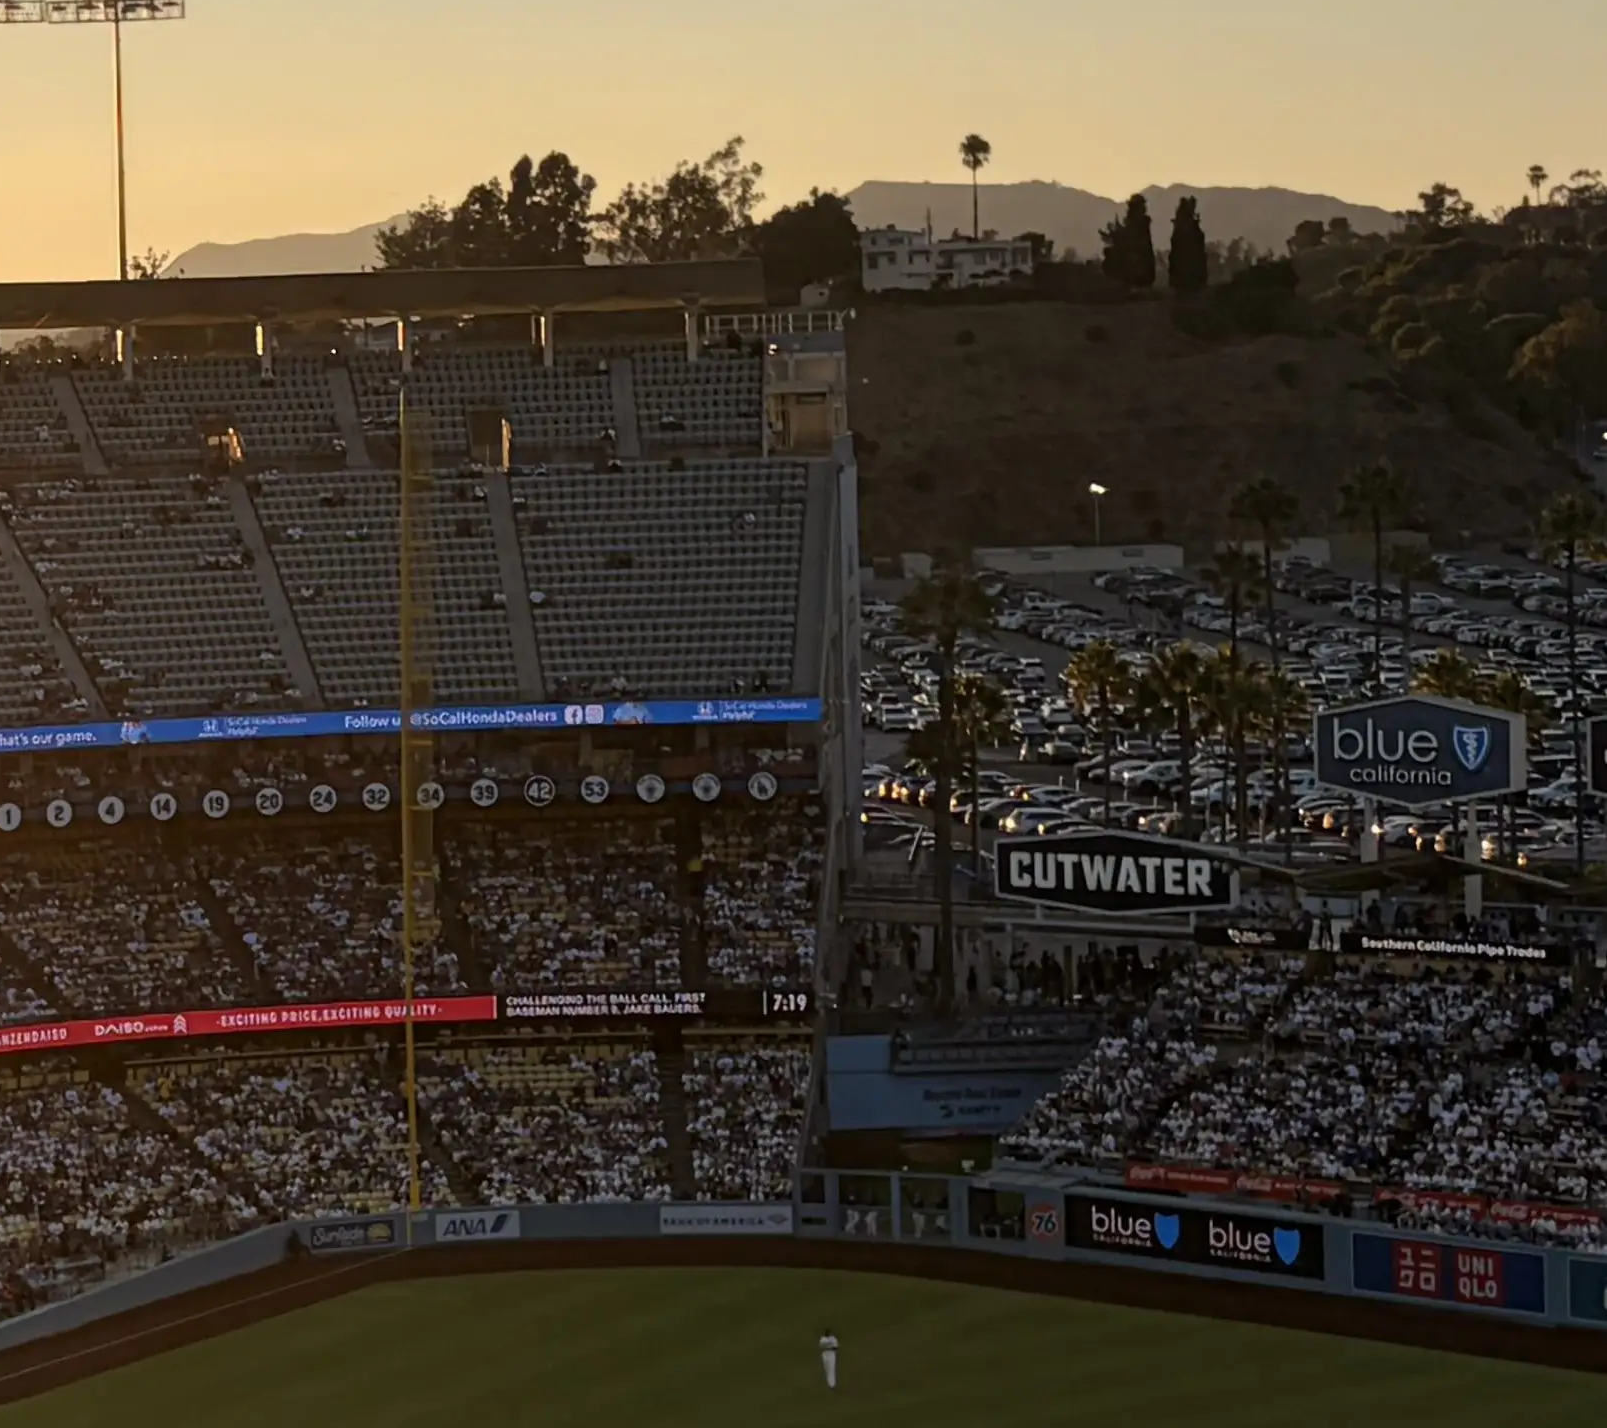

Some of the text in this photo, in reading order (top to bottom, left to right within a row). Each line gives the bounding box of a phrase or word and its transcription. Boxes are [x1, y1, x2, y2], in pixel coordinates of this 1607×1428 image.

[344, 715, 389, 728] Follow
[410, 709, 557, 726] @SoCalHondaDealers
[32, 734, 53, 745] our
[56, 730, 96, 747] game.
[1333, 717, 1438, 762] blue
[1350, 765, 1451, 786] california
[366, 789, 387, 804] 32
[421, 789, 440, 804] 34
[474, 785, 494, 801] 39
[528, 781, 551, 801] 42
[585, 781, 607, 797] 53
[155, 799, 171, 814] 14
[208, 796, 224, 812] 19
[260, 793, 278, 809] 20
[313, 791, 333, 807] 24
[5, 808, 12, 824] 1
[54, 806, 65, 821] 2
[105, 802, 115, 817] 4
[1010, 851, 1213, 896] CUTWATER
[1361, 936, 1546, 959] Southern California Pipe Trades
[506, 994, 584, 1006] CHALLENGING
[586, 994, 607, 1005] THE
[610, 993, 637, 1005] BALL
[674, 992, 705, 1004] FIRST
[773, 993, 808, 1012] 7:19
[506, 1005, 561, 1017] BASEMAN
[562, 1005, 609, 1016] NUMBER
[624, 1004, 650, 1015] JAKE
[94, 1021, 143, 1037] DAISO
[443, 1218, 487, 1236] ANA
[1034, 1210, 1057, 1233] 76
[1091, 1204, 1152, 1238] blue
[1093, 1232, 1153, 1248] CALIFORNIA
[1209, 1217, 1271, 1253] blue
[1210, 1249, 1271, 1263] CALIFORNIA
[1399, 1248, 1436, 1269] ユニ
[1458, 1253, 1493, 1277] UNI
[1399, 1269, 1436, 1292] クロ
[1459, 1276, 1498, 1299] QLO
